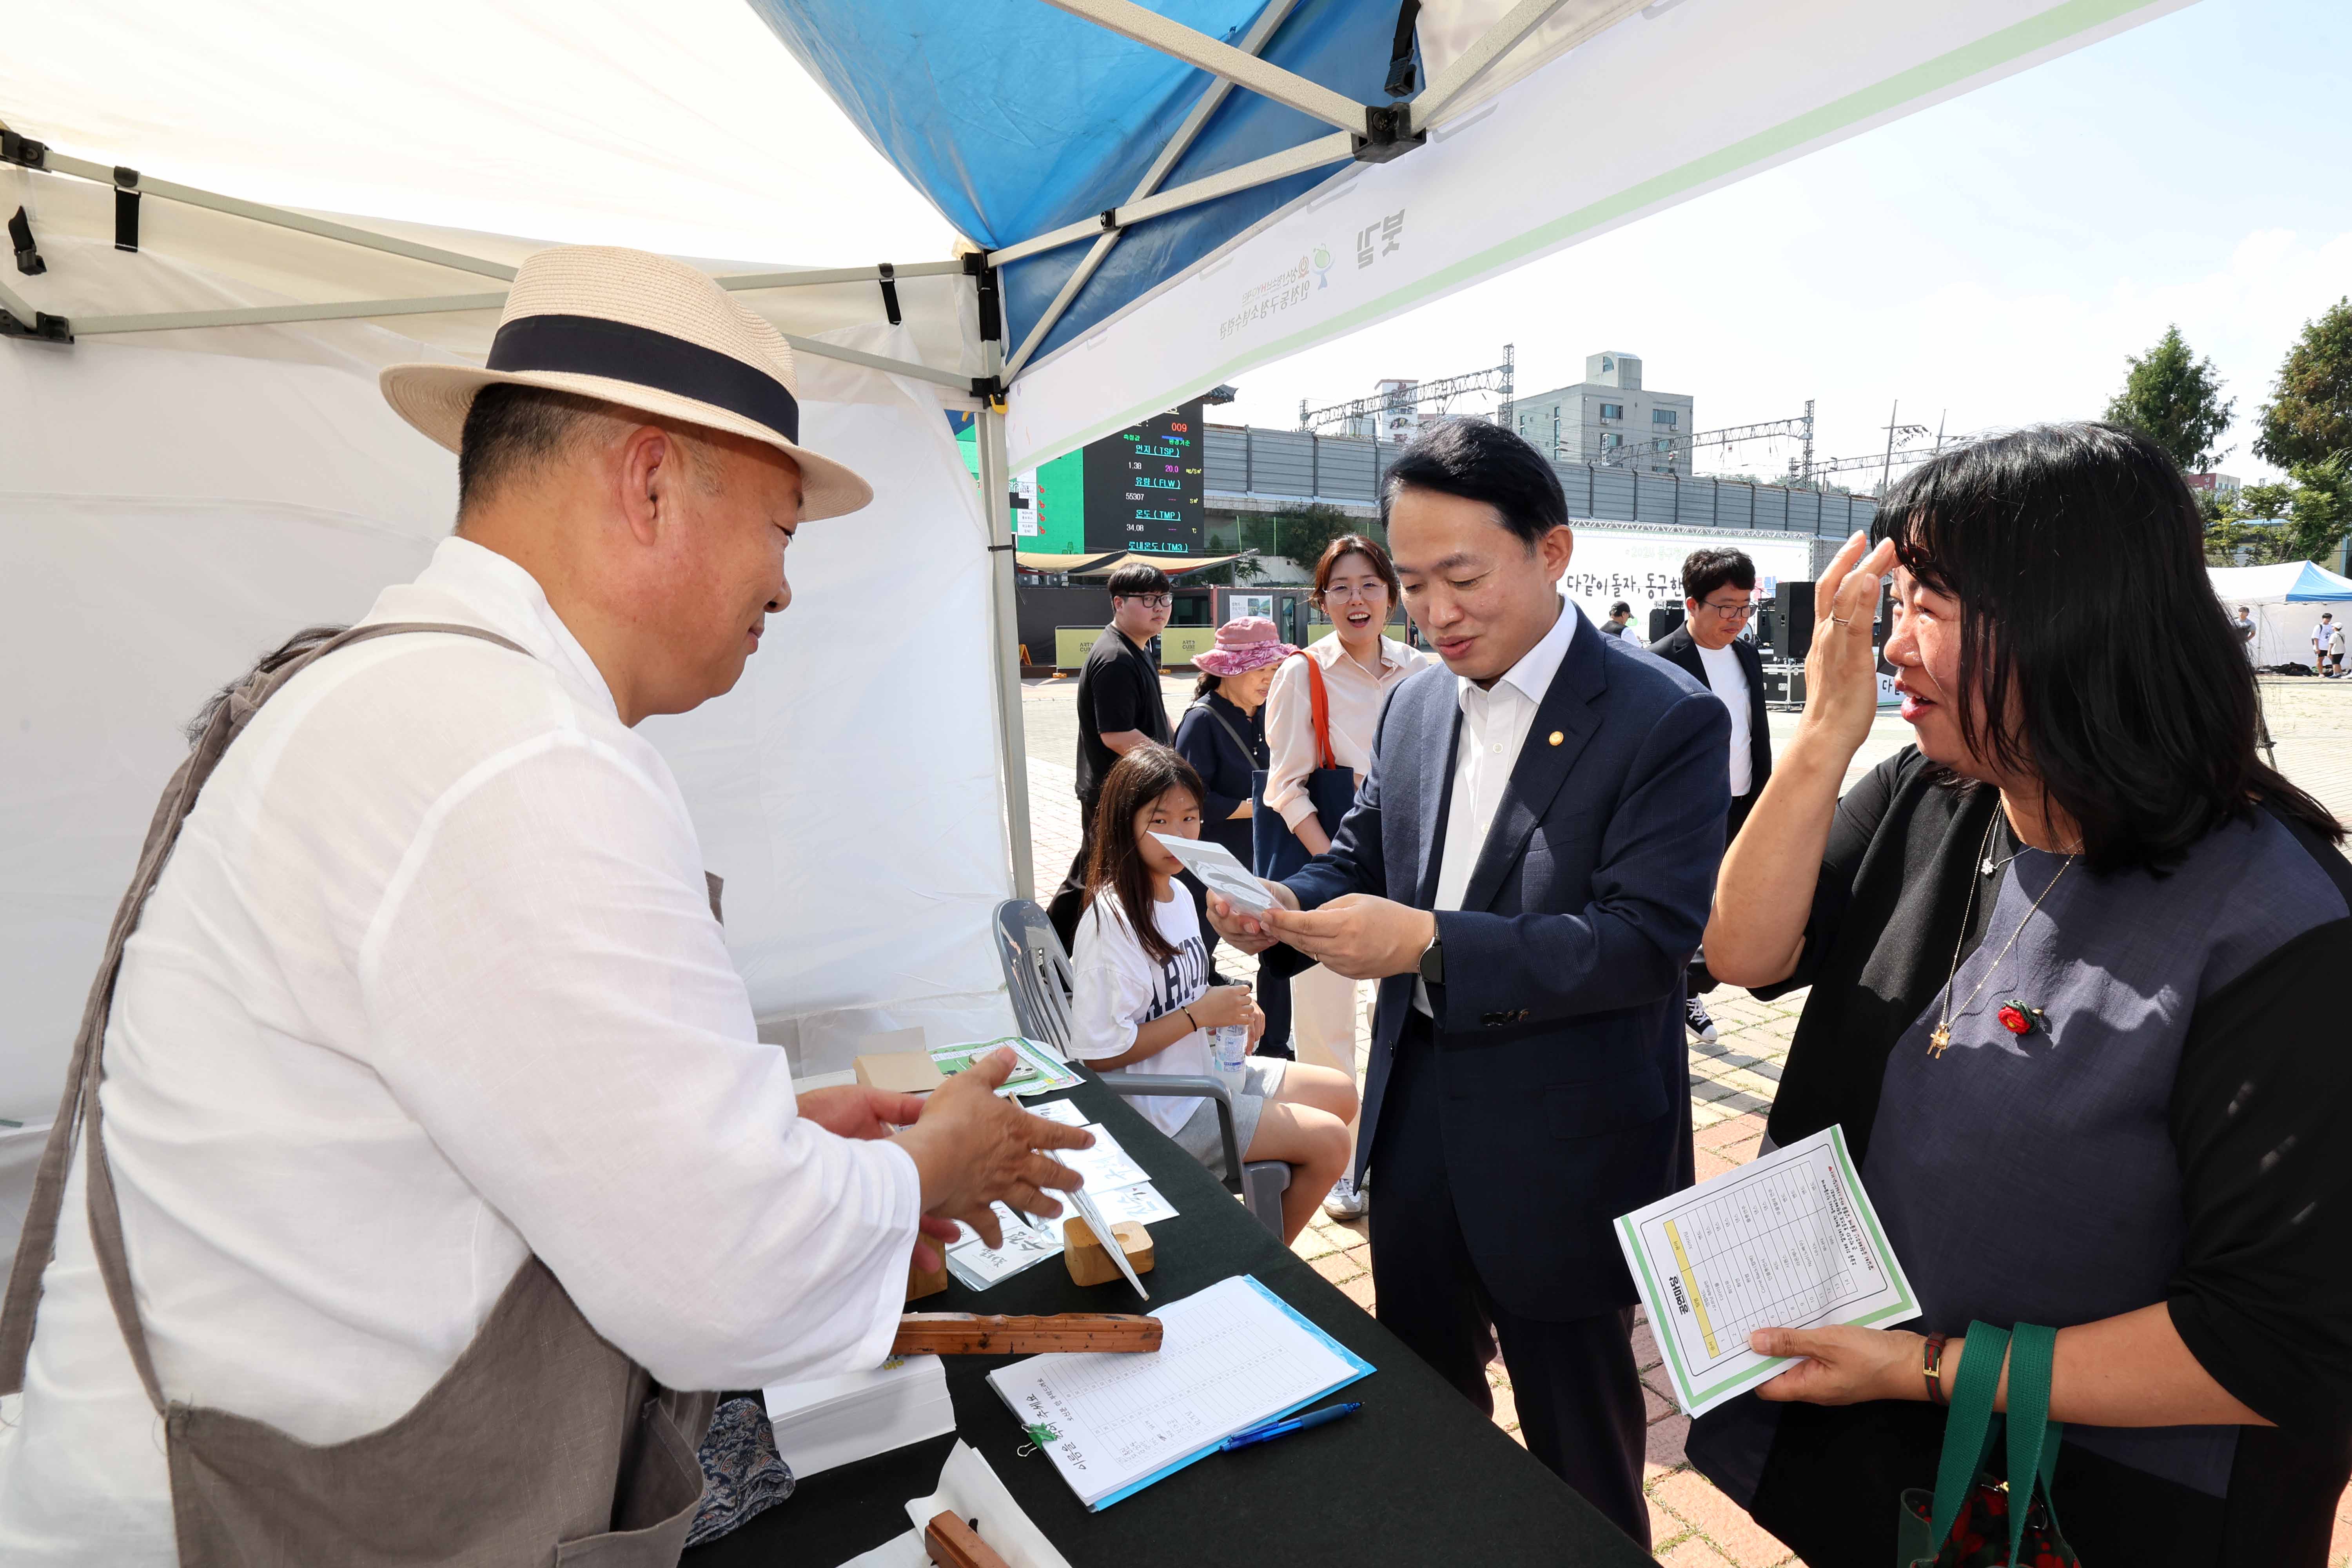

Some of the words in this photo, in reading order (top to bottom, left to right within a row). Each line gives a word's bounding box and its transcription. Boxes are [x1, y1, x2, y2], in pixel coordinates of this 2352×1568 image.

[1171, 423, 1187, 432] 009
[1136, 445, 1150, 454] 먼지
[1135, 477, 1150, 486] 유량
[1129, 542, 1158, 550] 로내온도
[1800, 1185, 1807, 1195] 밴드
[1810, 1181, 1817, 1191] 밴드
[1781, 1193, 1788, 1203] 밴드
[1790, 1190, 1797, 1199] 밴드
[1753, 1205, 1759, 1215] 댄스
[1762, 1201, 1769, 1211] 댄스
[1724, 1218, 1730, 1227] 댄스
[1734, 1213, 1740, 1223] 댄스
[1706, 1226, 1712, 1236] 댄스
[1715, 1221, 1721, 1232] 댄스
[1838, 1229, 1846, 1243] 열심히
[1846, 1232, 1854, 1245] 박수와
[1844, 1243, 1851, 1254] 위해
[1864, 1256, 1874, 1270] 열심히
[1669, 1276, 1688, 1315] 공연마당
[1708, 1341, 1715, 1351] 순서
[1026, 1393, 1049, 1419] 주세요
